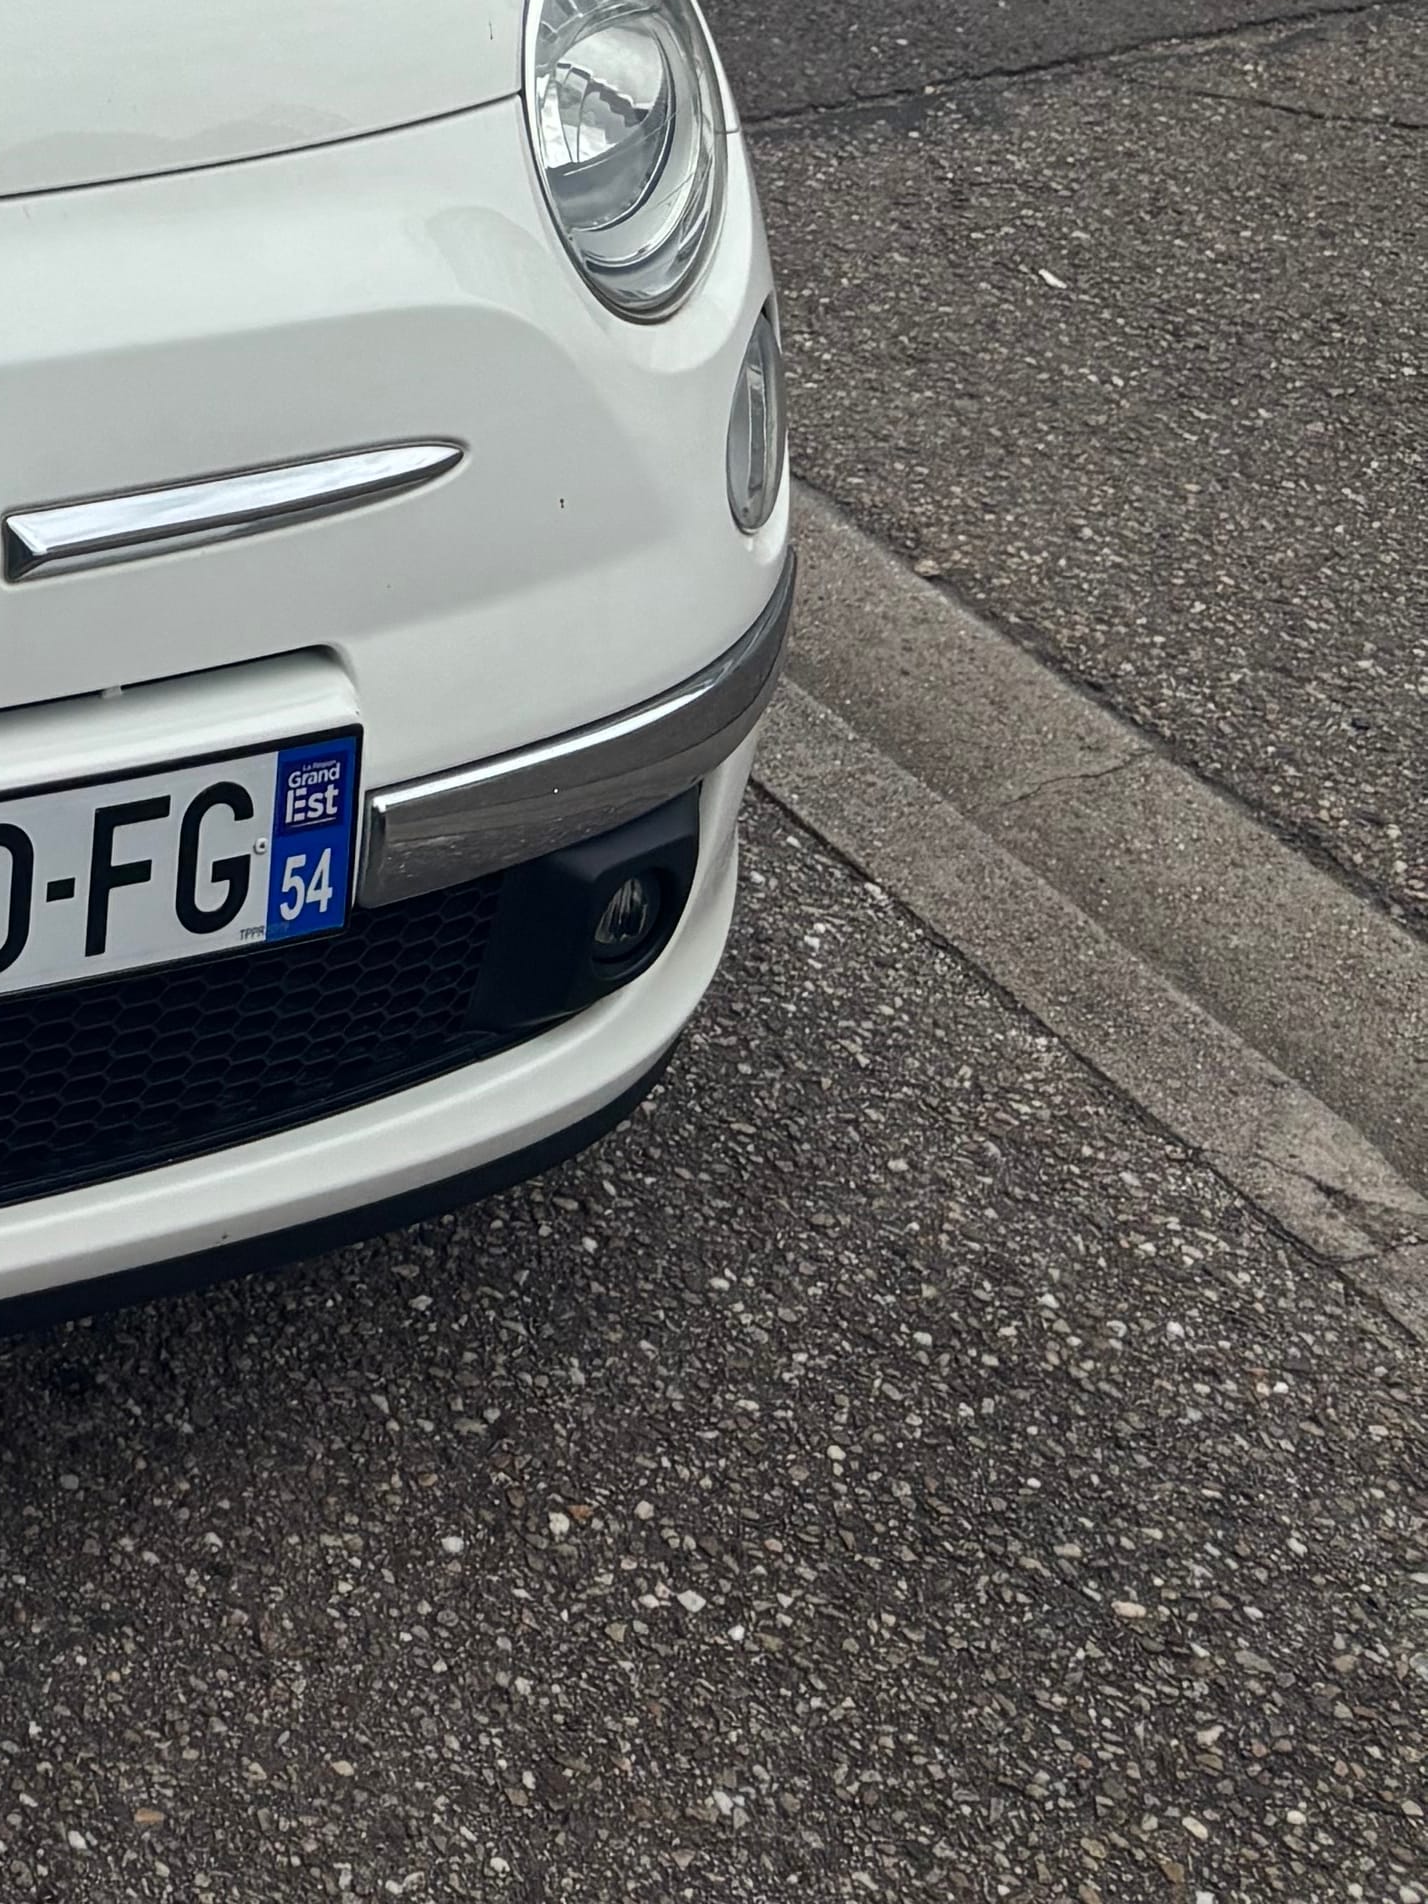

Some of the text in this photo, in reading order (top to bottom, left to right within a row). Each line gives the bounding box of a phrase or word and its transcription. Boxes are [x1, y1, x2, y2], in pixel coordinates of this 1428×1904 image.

[288, 762, 341, 788] Grand
[285, 784, 340, 824] Est
[279, 847, 333, 921] 54
